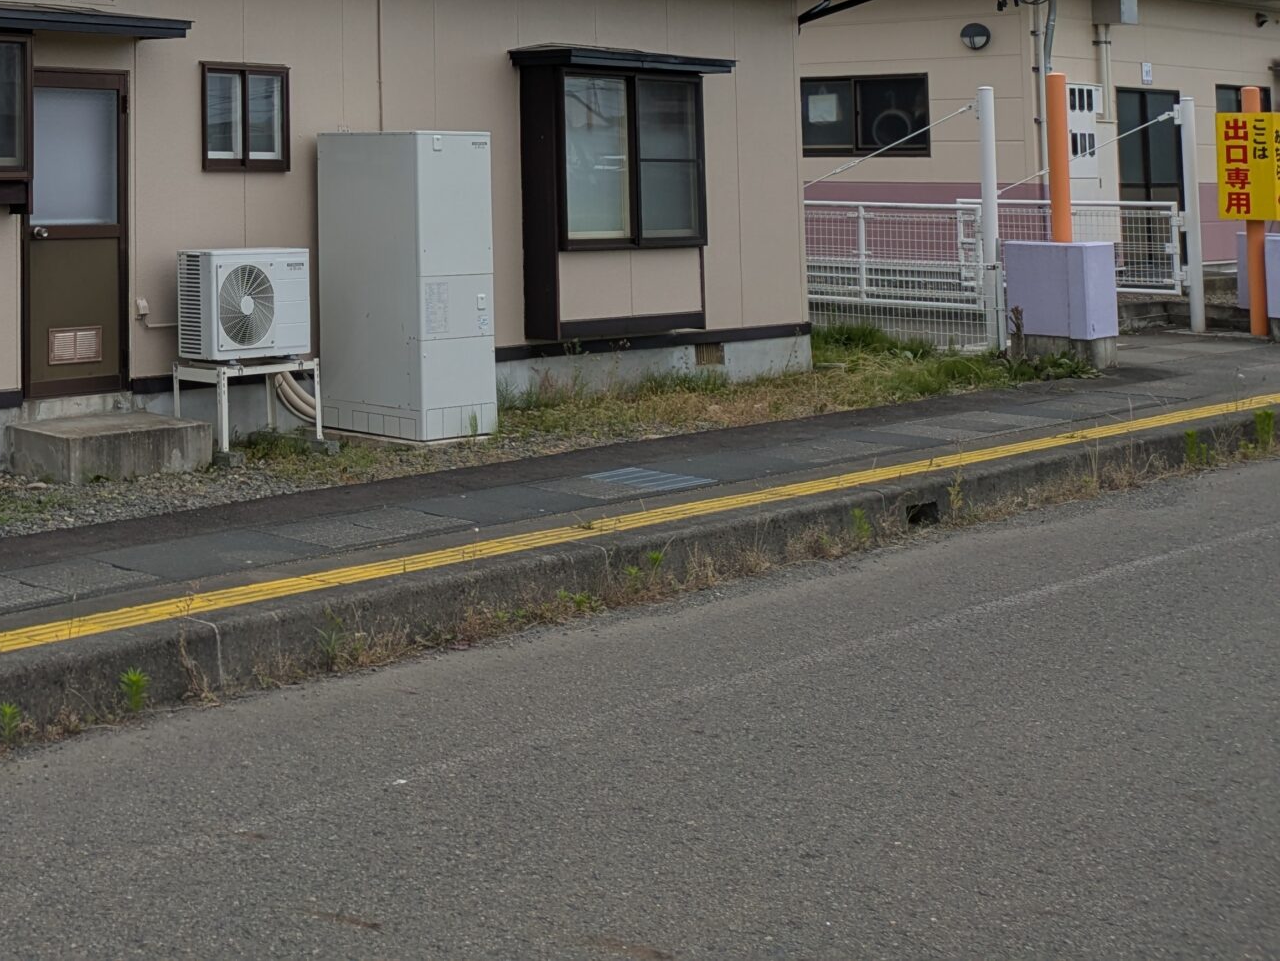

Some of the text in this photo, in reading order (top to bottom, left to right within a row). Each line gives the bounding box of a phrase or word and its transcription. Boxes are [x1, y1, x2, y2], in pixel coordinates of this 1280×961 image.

[1224, 118, 1252, 215] 出口専用
[1253, 118, 1269, 160] ここは
